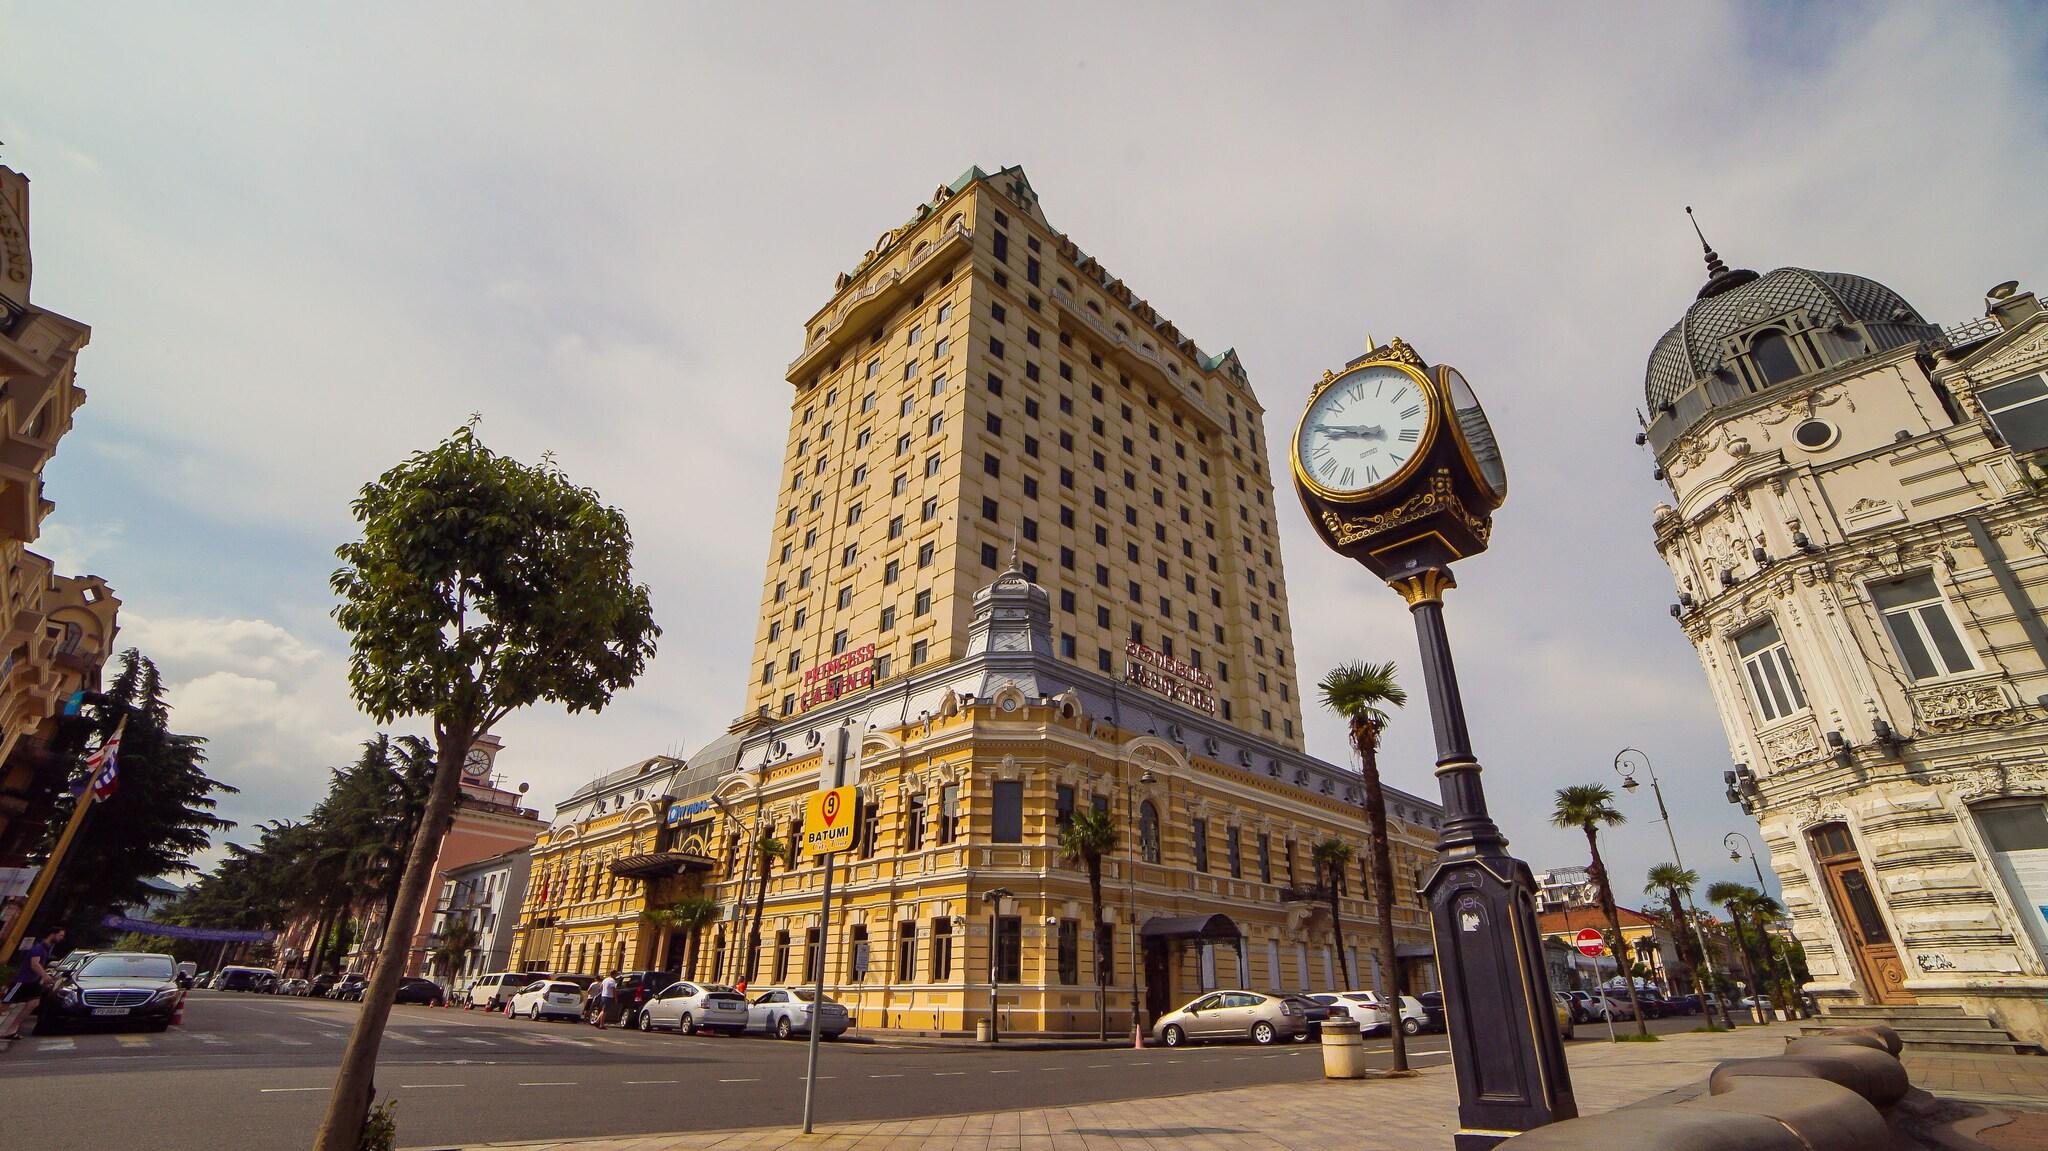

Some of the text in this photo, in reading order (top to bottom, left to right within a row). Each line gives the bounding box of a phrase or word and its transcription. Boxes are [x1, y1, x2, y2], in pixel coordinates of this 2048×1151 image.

[803, 642, 876, 688] PRINCESS
[799, 666, 874, 713] CASINO
[827, 797, 835, 814] 9
[808, 826, 849, 843] BATUMI
